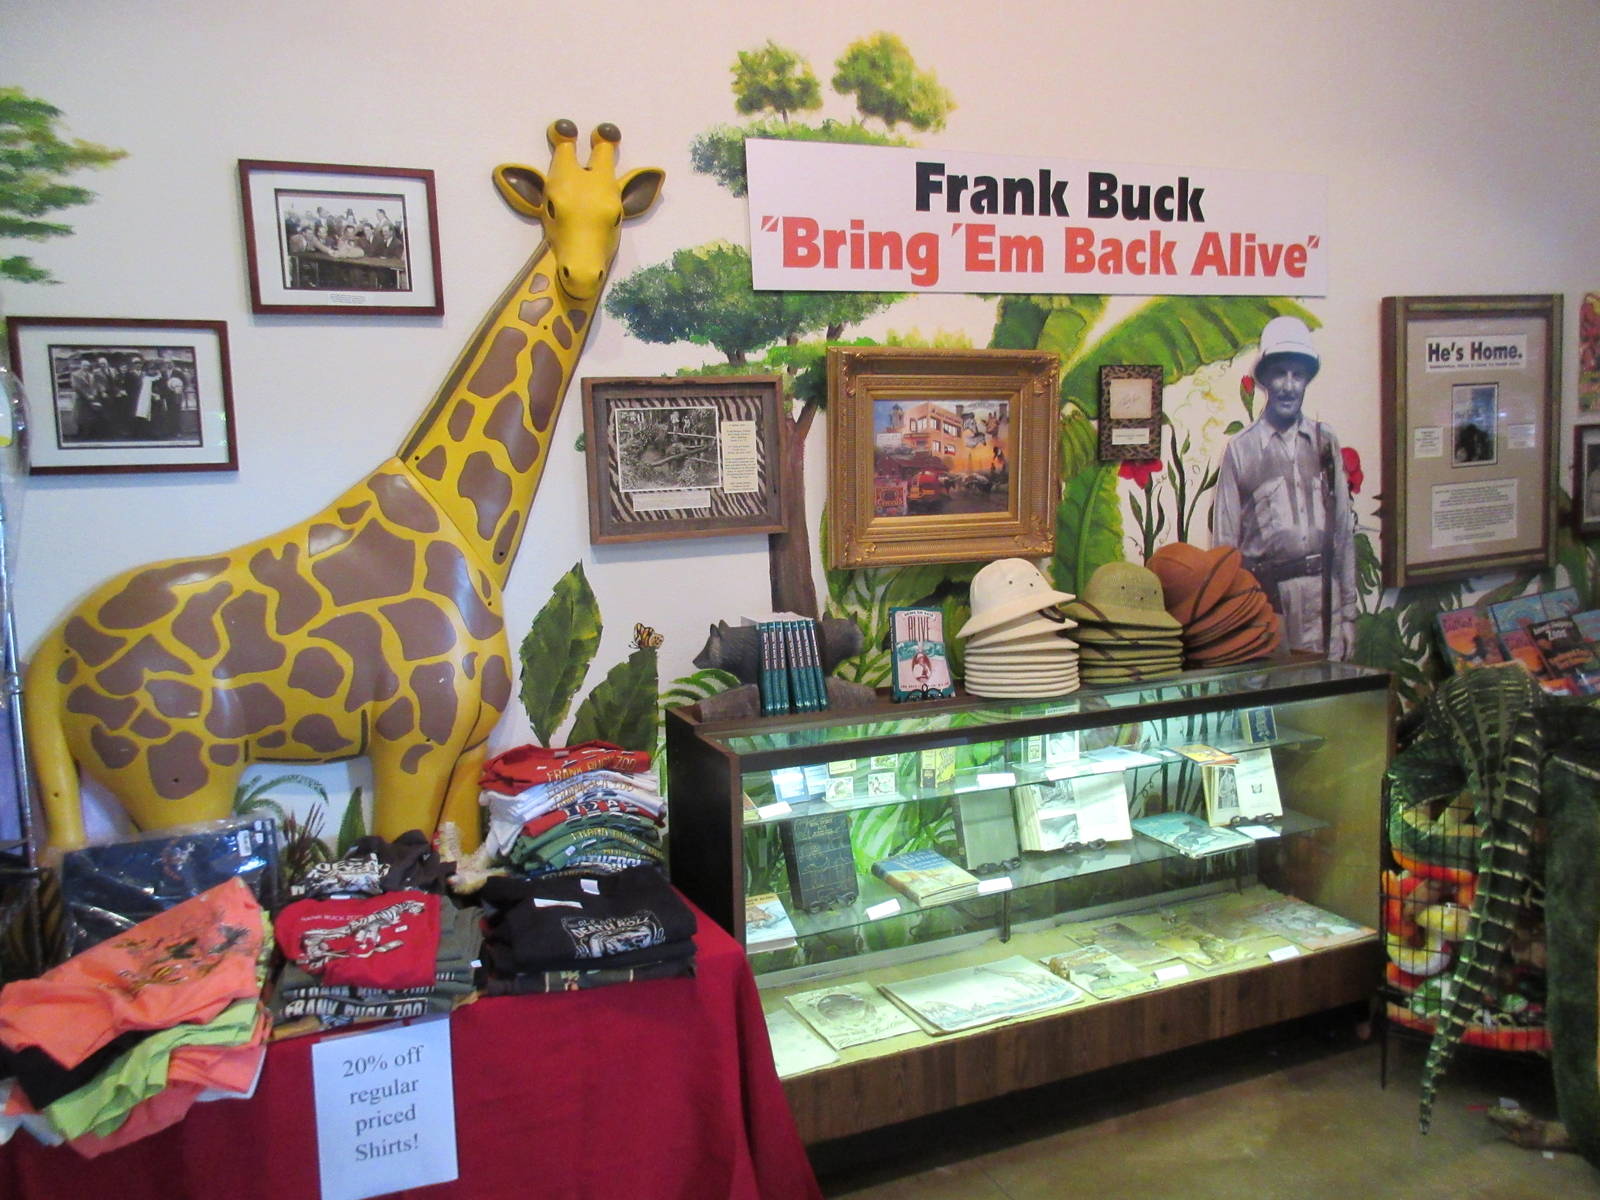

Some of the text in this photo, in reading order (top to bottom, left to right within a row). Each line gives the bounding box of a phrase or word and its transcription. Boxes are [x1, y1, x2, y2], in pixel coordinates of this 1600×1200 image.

[915, 161, 1206, 223] Frank Buck
[760, 215, 940, 287] "Bring
[1064, 226, 1178, 276] Back
[1191, 230, 1320, 278] Alive"
[1428, 341, 1523, 362] He's Home.
[570, 922, 617, 939] DEATH
[342, 1045, 425, 1078] 20% off
[350, 1078, 420, 1105] regular
[355, 1103, 417, 1137] priced
[355, 1133, 420, 1162] Shirts!
